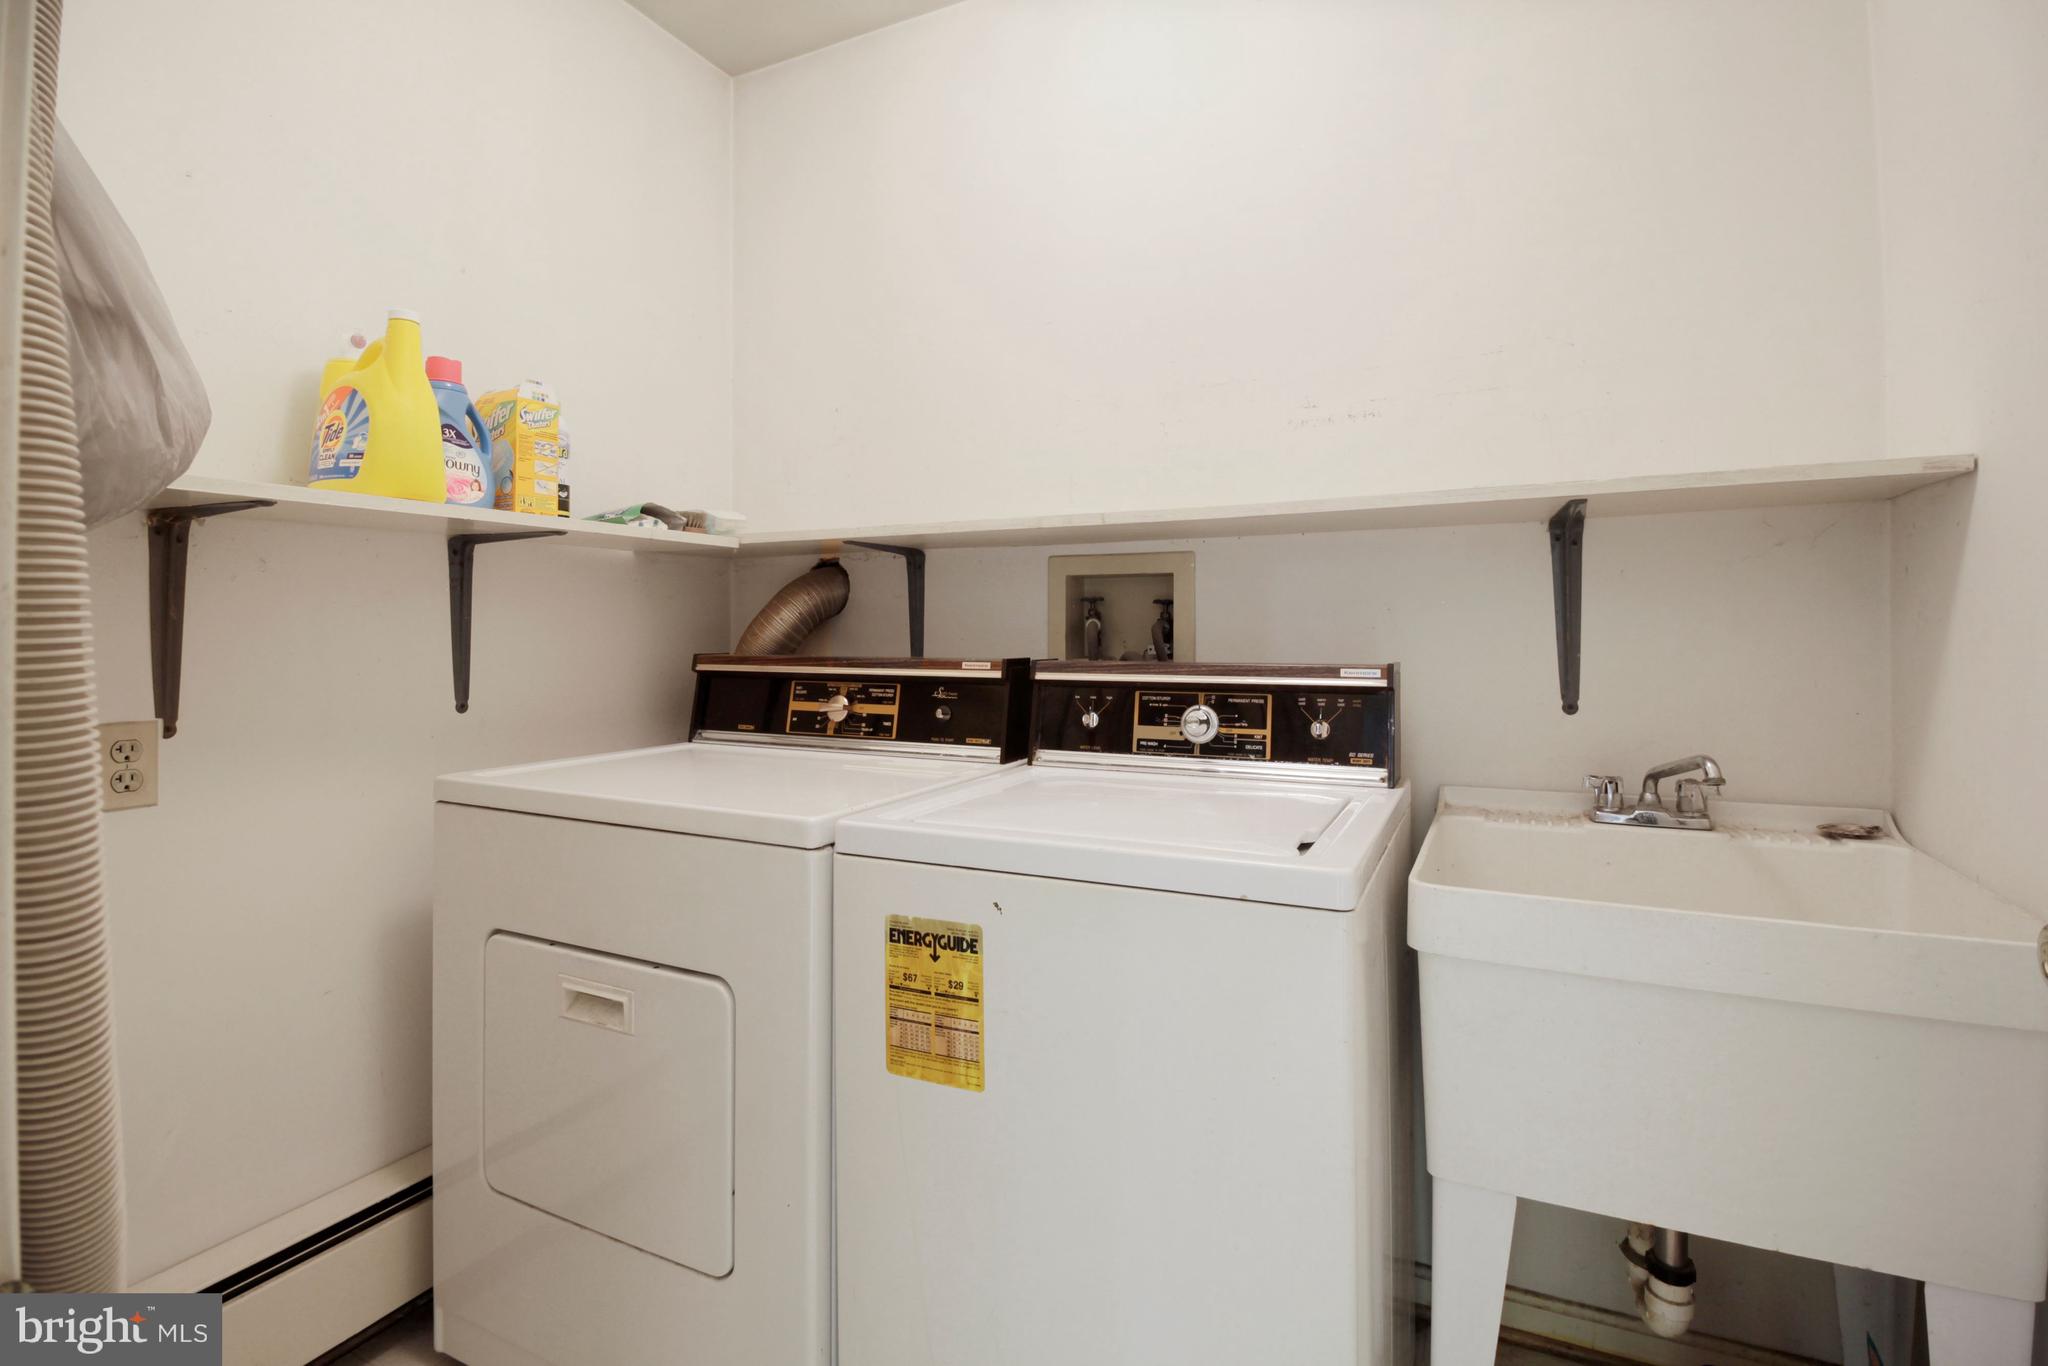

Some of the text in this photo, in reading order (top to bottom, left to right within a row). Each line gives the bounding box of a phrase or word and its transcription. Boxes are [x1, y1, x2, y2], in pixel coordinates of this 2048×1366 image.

[520, 405, 558, 423] Swiffer
[321, 422, 344, 448] Tide
[442, 428, 457, 439] 3X
[444, 457, 481, 478] owny
[889, 928, 978, 957] ENERGYGUIDE
[902, 972, 918, 983] $67
[948, 980, 964, 991] $29
